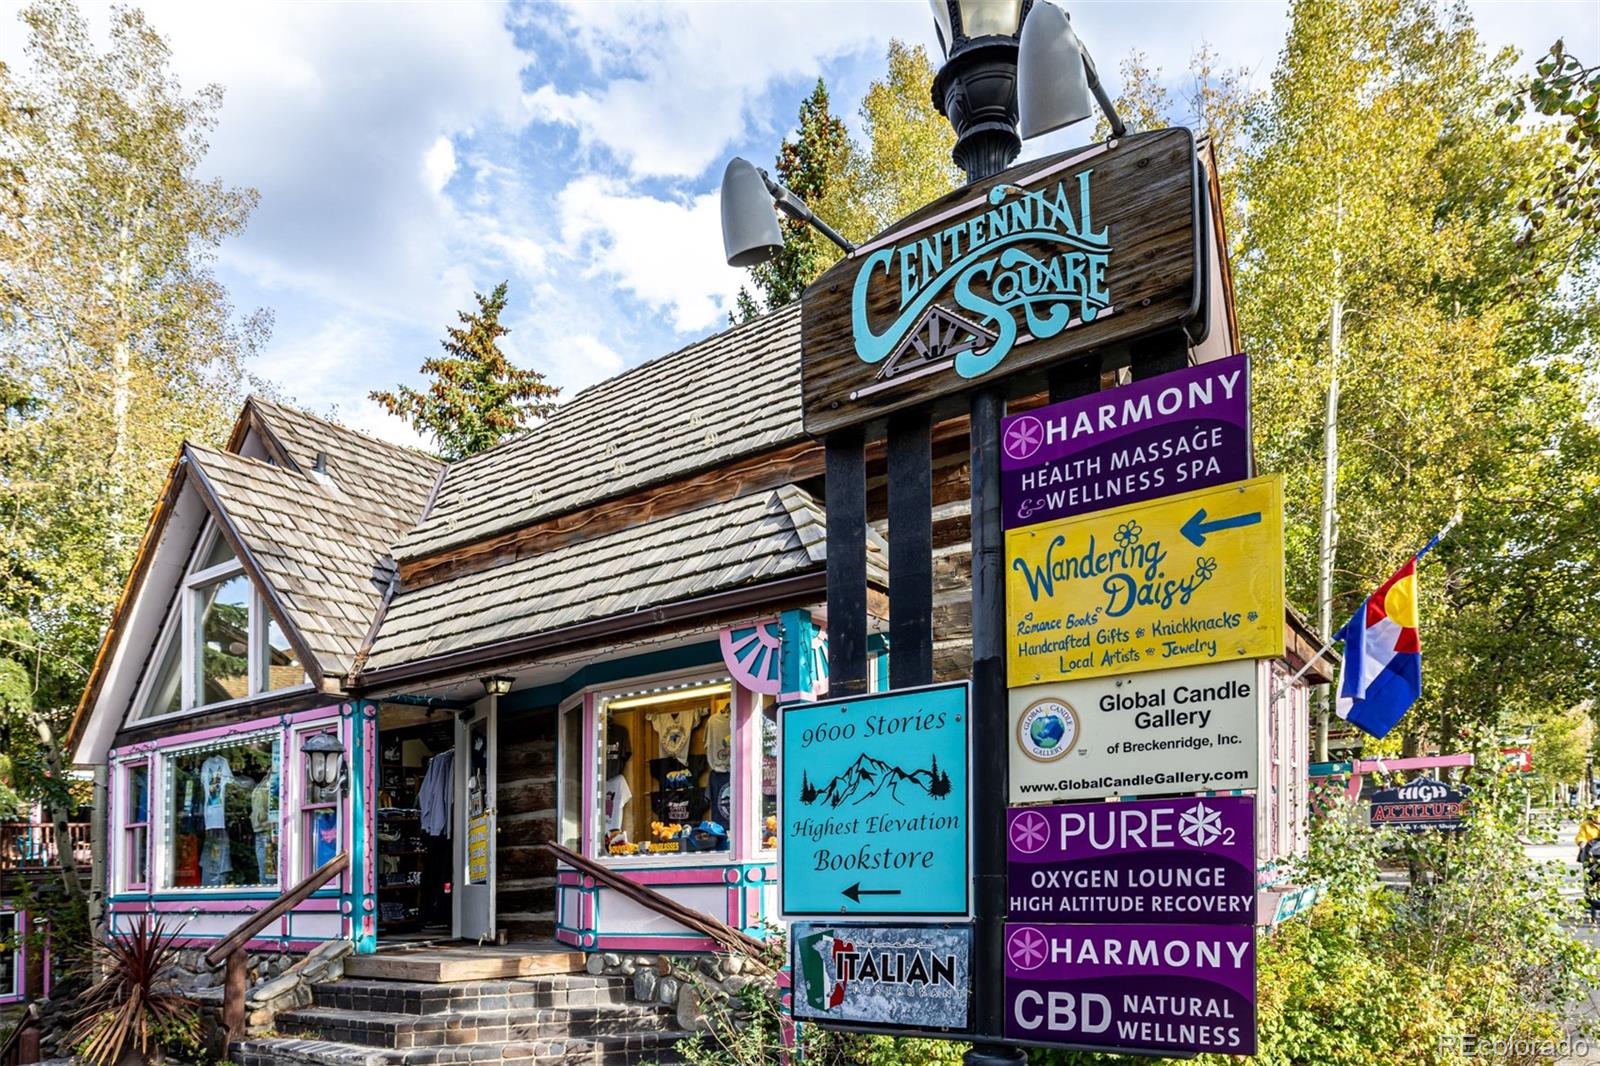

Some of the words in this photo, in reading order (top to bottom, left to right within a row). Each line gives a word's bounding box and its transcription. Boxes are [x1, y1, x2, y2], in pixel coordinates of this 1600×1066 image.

[852, 168, 1114, 364] CENTENNIAL
[953, 248, 1110, 379] SQUARE
[1046, 370, 1241, 445] HARMONY
[1021, 456, 1101, 491] HEALTH
[1110, 427, 1223, 471] MASSAGE
[1017, 498, 1046, 519] &
[1046, 468, 1166, 510] WELLNESS
[1177, 456, 1221, 483] SPA
[1013, 534, 1167, 601] Wandering
[1103, 570, 1200, 617] Daisy
[1017, 619, 1062, 636] Romance
[1066, 613, 1098, 630] Books
[1018, 635, 1090, 657] Handcrafted
[1096, 628, 1129, 645] Gifts
[1152, 612, 1241, 637] Knickknacks
[1060, 652, 1094, 673] Local
[1102, 646, 1140, 667] Artists
[1162, 638, 1217, 659] Jewelry
[1099, 689, 1166, 713] Global
[1173, 681, 1251, 705] Candle
[801, 722, 856, 748] 9600
[864, 708, 947, 738] Stories
[1023, 706, 1043, 731] GLOBAL
[1050, 704, 1073, 726] CANDLE
[1134, 709, 1212, 730] Gallery
[1032, 745, 1063, 757] GALLERY
[1106, 742, 1119, 755] of
[1123, 737, 1213, 754] Breckenridge,
[1217, 733, 1242, 747] Inc.
[1020, 769, 1249, 793] www.GlobalCandleGallery.com
[1398, 785, 1448, 802] HIGH
[791, 816, 859, 842] Highest
[865, 812, 960, 834] Elevation
[813, 843, 934, 872] Bookstore
[1031, 869, 1118, 889] OXYGEN
[1128, 868, 1226, 888] LOUNGE
[1010, 896, 1053, 912] HIGH
[1059, 896, 1144, 912] ALTITUDE
[1151, 895, 1253, 912] RECOVERY
[1051, 938, 1250, 968] HARMONY
[835, 949, 957, 990] ITALIAN
[1014, 989, 1112, 1033] CBD
[1123, 994, 1235, 1019] NATURAL
[1117, 1021, 1241, 1047] WELLNESS
